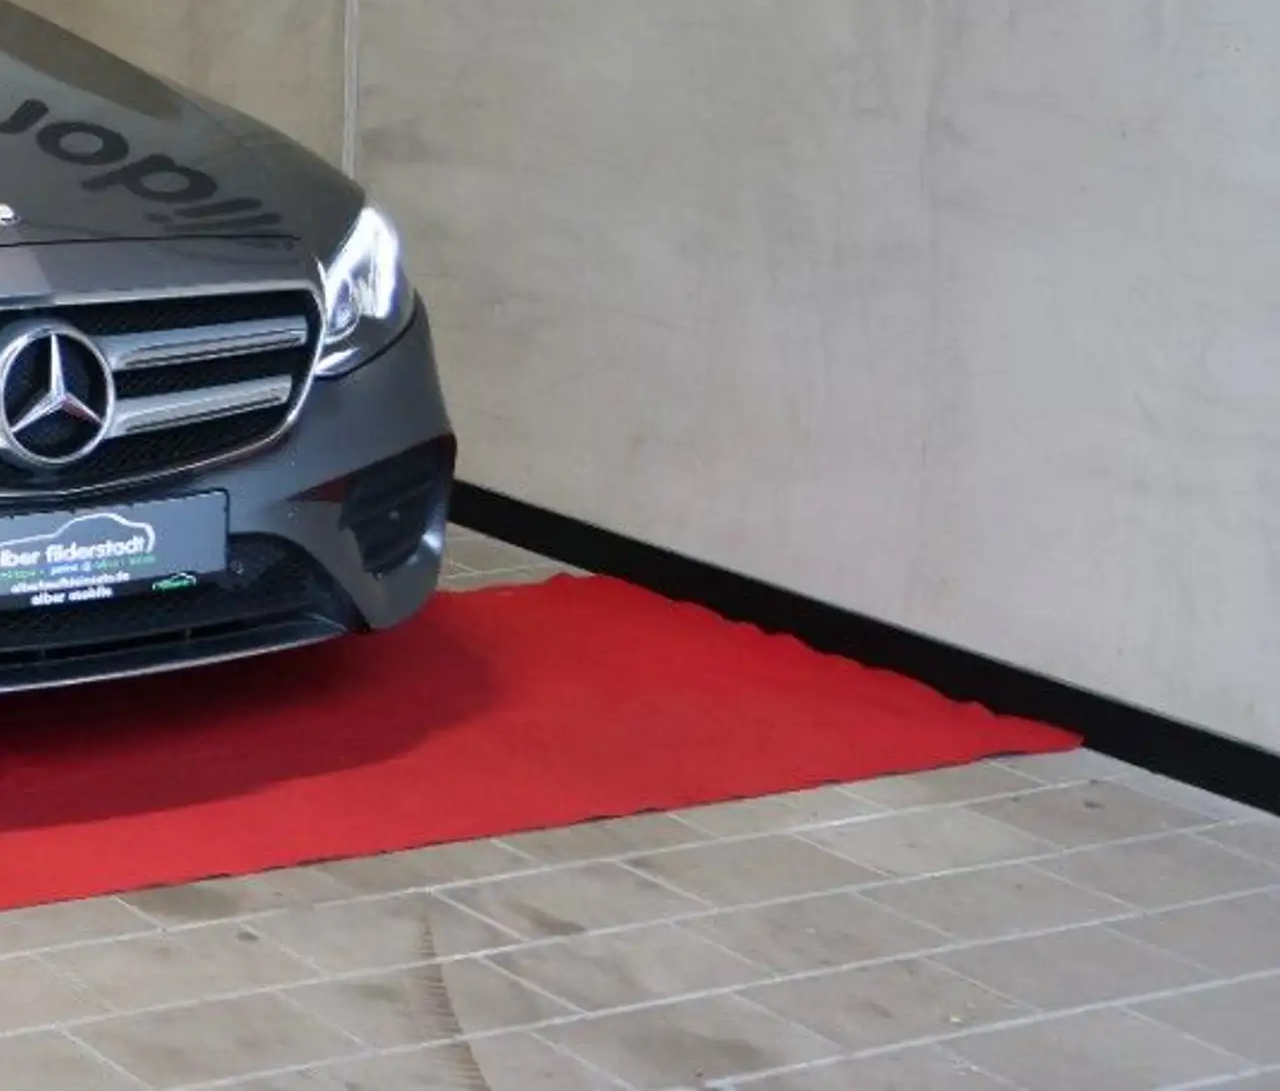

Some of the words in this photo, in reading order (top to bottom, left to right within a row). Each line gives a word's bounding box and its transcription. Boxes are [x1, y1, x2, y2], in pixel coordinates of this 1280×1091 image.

[45, 536, 146, 562] filderstadt
[30, 590, 65, 606] alber
[68, 586, 113, 602] mobile
